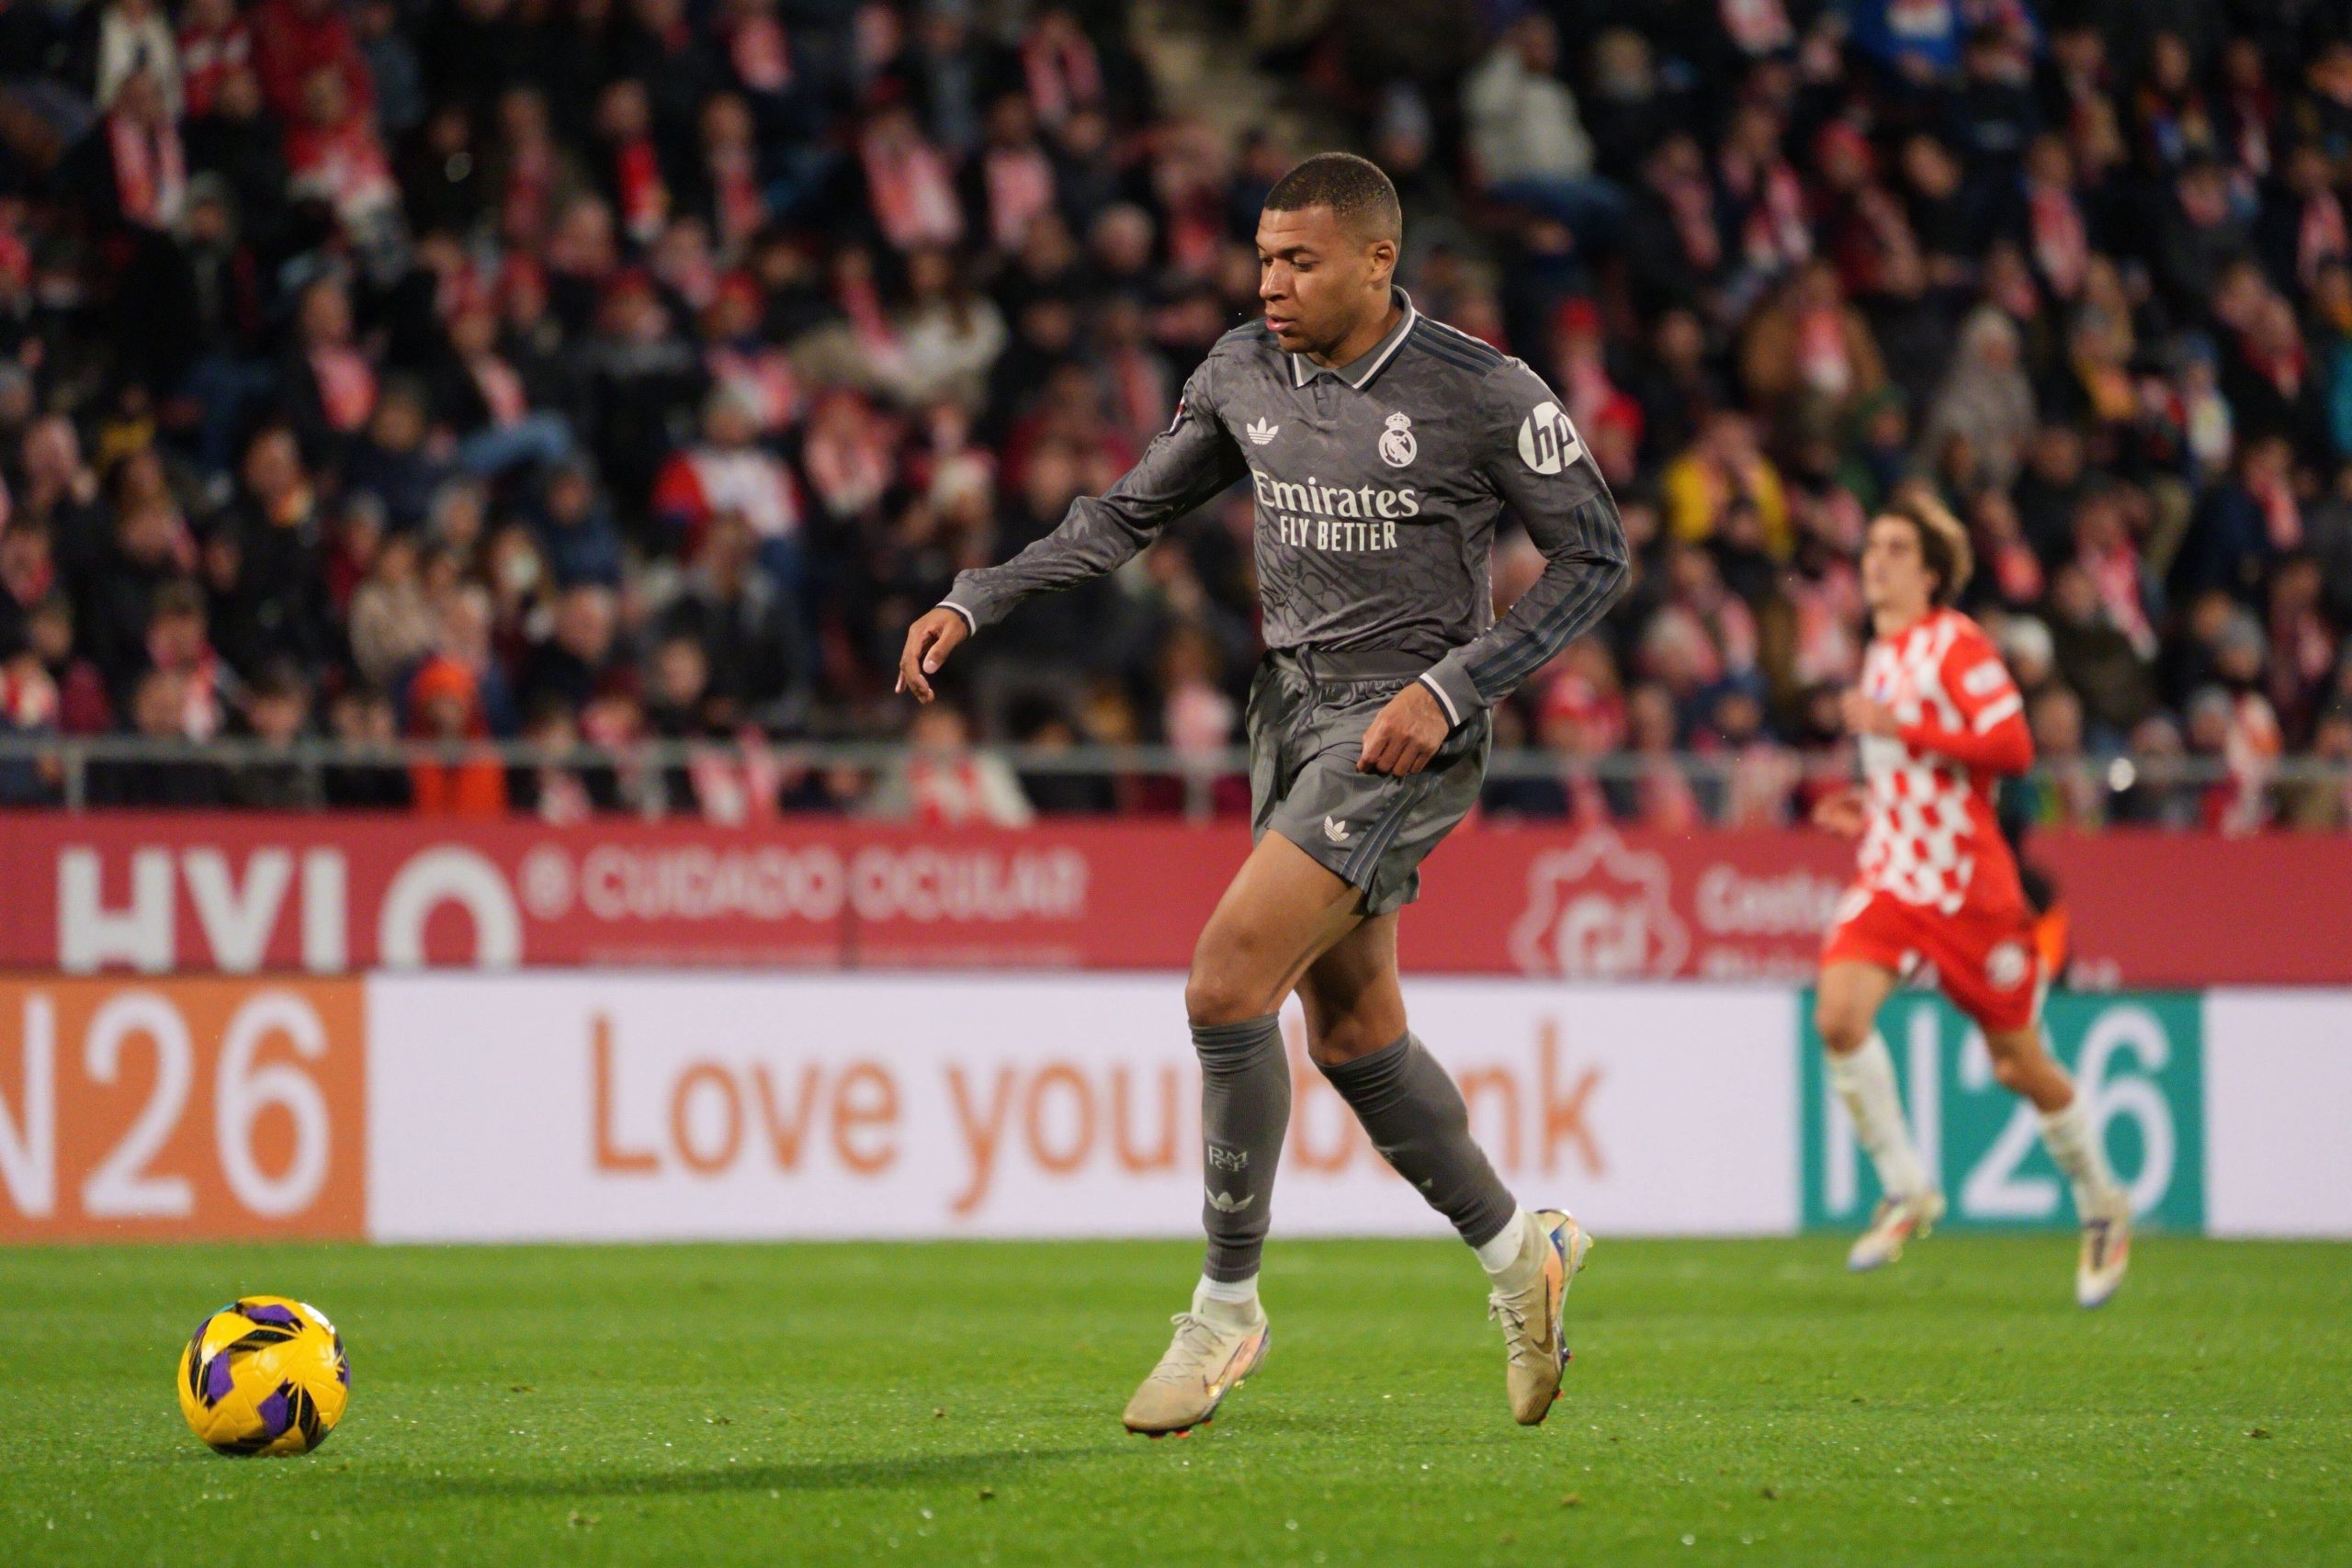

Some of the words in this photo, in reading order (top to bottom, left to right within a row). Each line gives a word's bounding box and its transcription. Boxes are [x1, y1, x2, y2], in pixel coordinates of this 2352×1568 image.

[1525, 405, 1577, 472] hp
[1251, 468, 1420, 519] Emirates
[1280, 514, 1309, 548] FLY
[1317, 520, 1398, 552] BETTER
[590, 1010, 899, 1174] Love
[945, 1063, 1180, 1216] you
[1289, 1014, 1604, 1174] bnk
